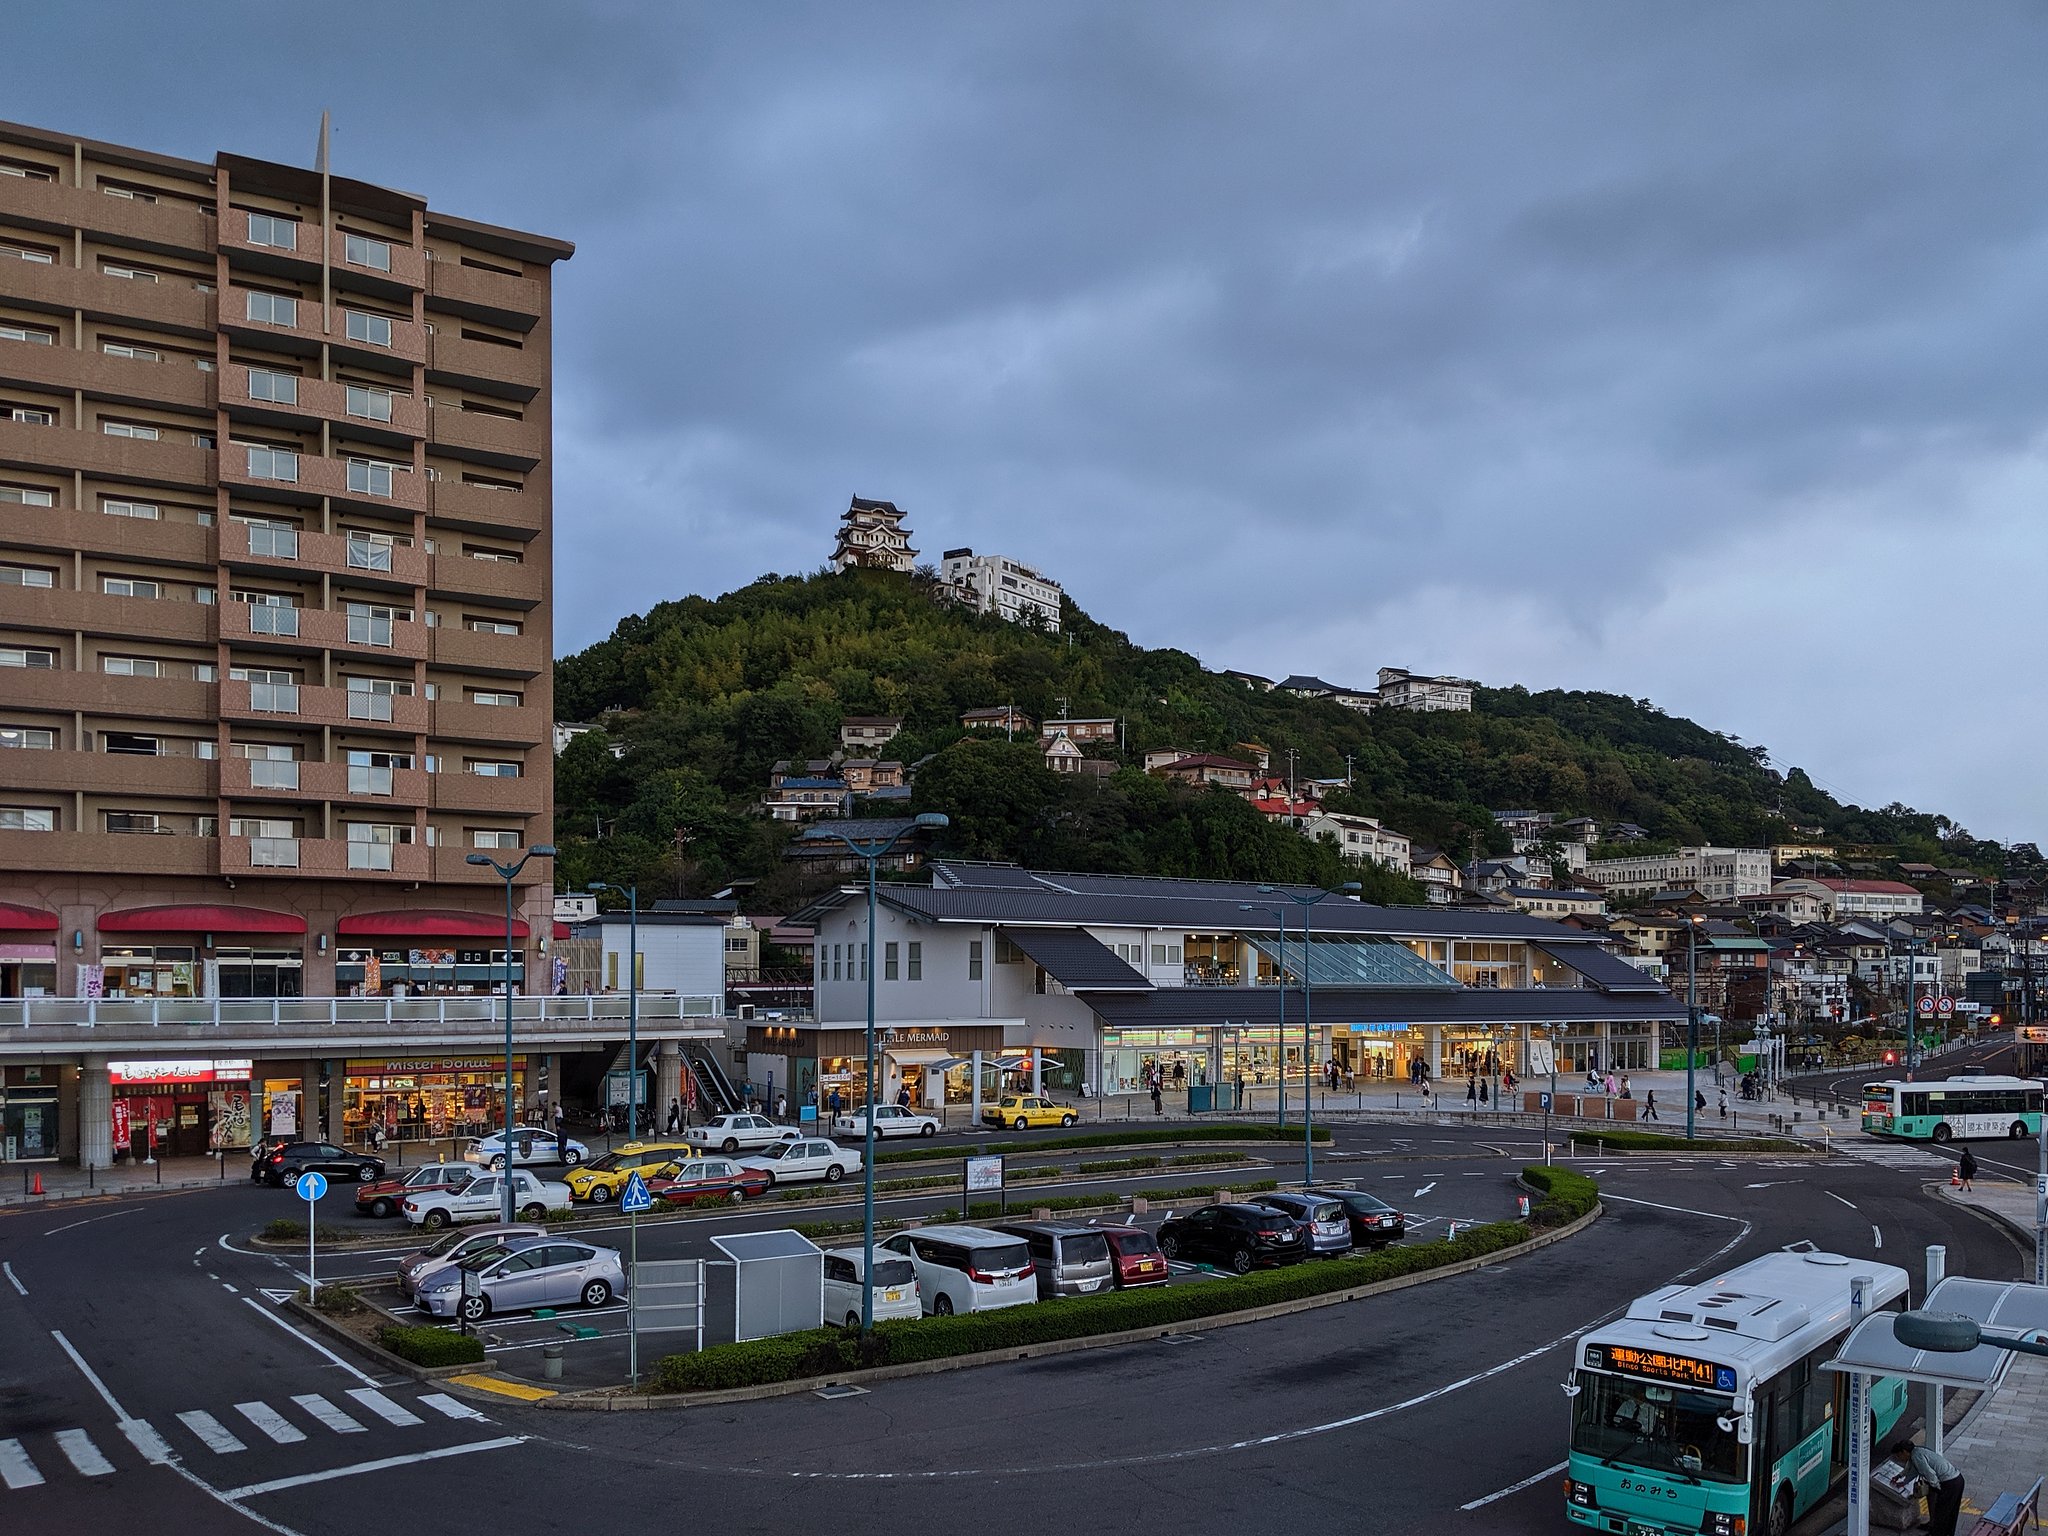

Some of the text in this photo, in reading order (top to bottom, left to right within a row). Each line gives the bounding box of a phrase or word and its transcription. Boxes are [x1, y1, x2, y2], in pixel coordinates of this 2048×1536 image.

[907, 1032, 950, 1042] MERMAID
[386, 1057, 492, 1071] Mister Donut
[1541, 1094, 1549, 1107] P
[2038, 1181, 2046, 1193] 5
[1851, 1289, 1863, 1308] 4
[1610, 1347, 1695, 1373] 運動公園北門
[1696, 1363, 1711, 1379] 41
[1642, 1365, 1668, 1376] Sports
[1671, 1371, 1690, 1380] Park
[1620, 1478, 1678, 1499] おのみち
